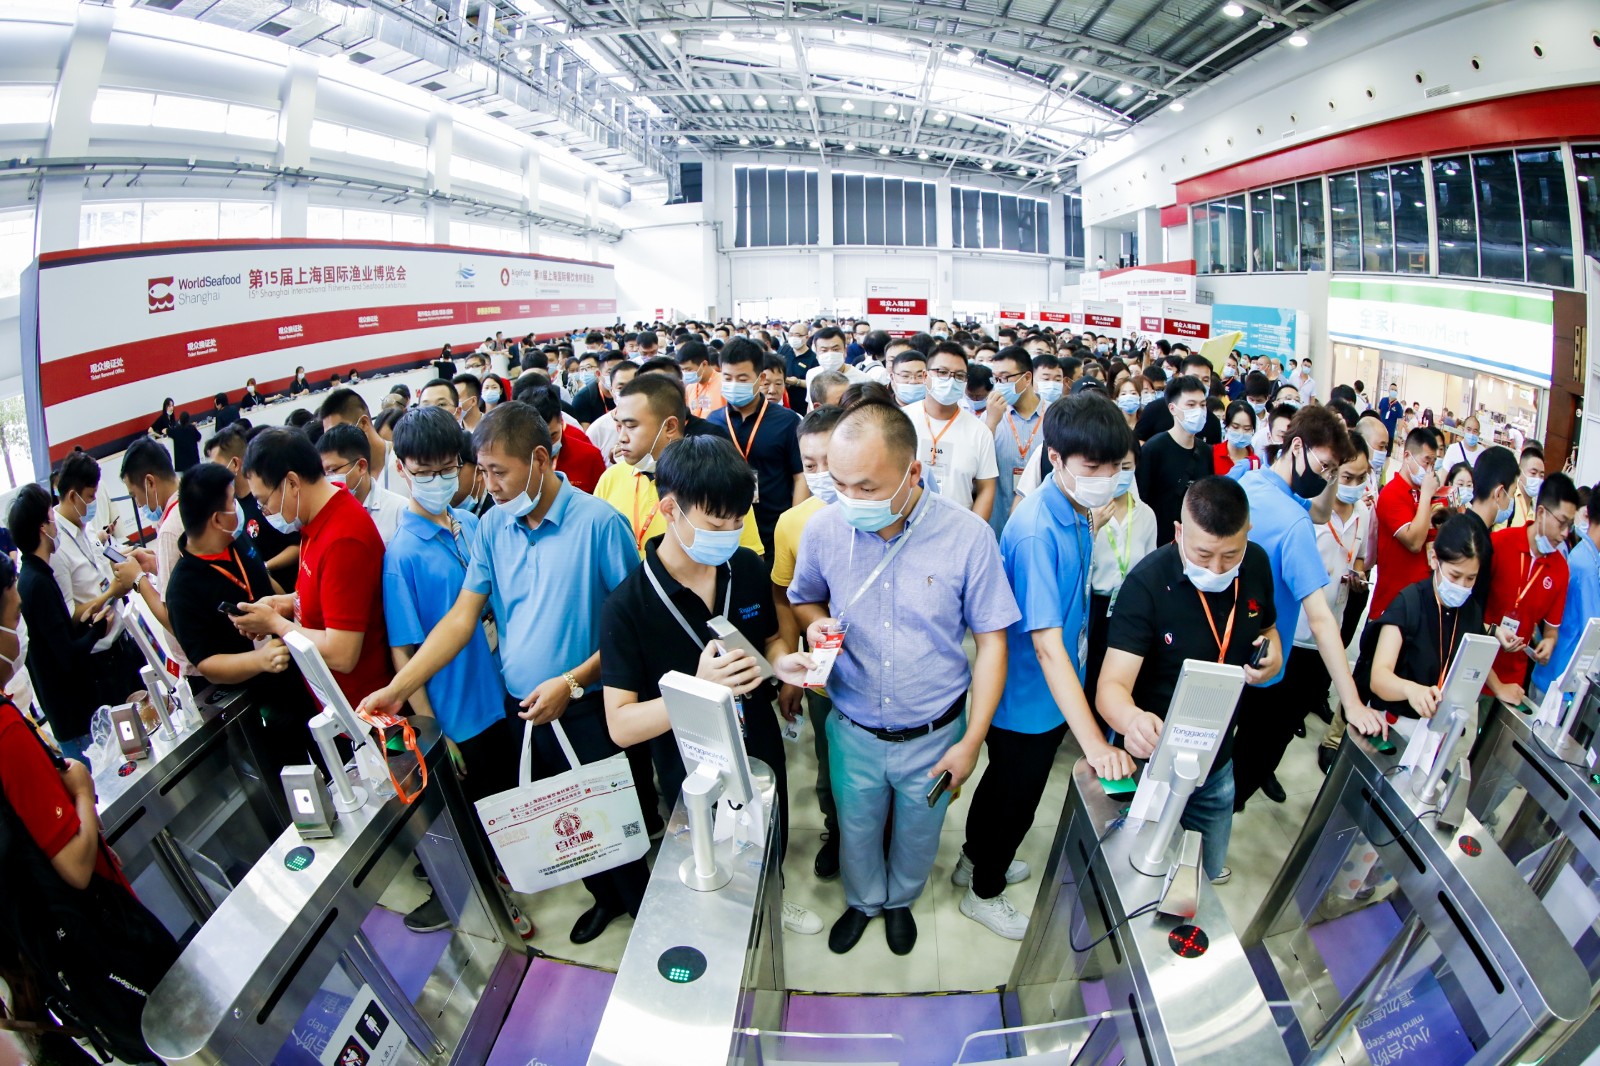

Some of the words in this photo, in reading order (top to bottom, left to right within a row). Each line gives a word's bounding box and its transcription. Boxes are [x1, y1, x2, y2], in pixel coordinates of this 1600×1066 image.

[179, 274, 240, 290] WorldSeafood
[249, 265, 406, 289] 第15届上海国际渔业博览会
[178, 289, 220, 305] Shanghai
[260, 288, 289, 299] Shanghai
[90, 357, 124, 373] 观众换证处
[307, 1018, 329, 1033] step
[1403, 1014, 1424, 1029] mind
[1386, 1027, 1403, 1039] the
[1365, 1034, 1386, 1050] step
[1372, 1026, 1430, 1066] 小心台阶
